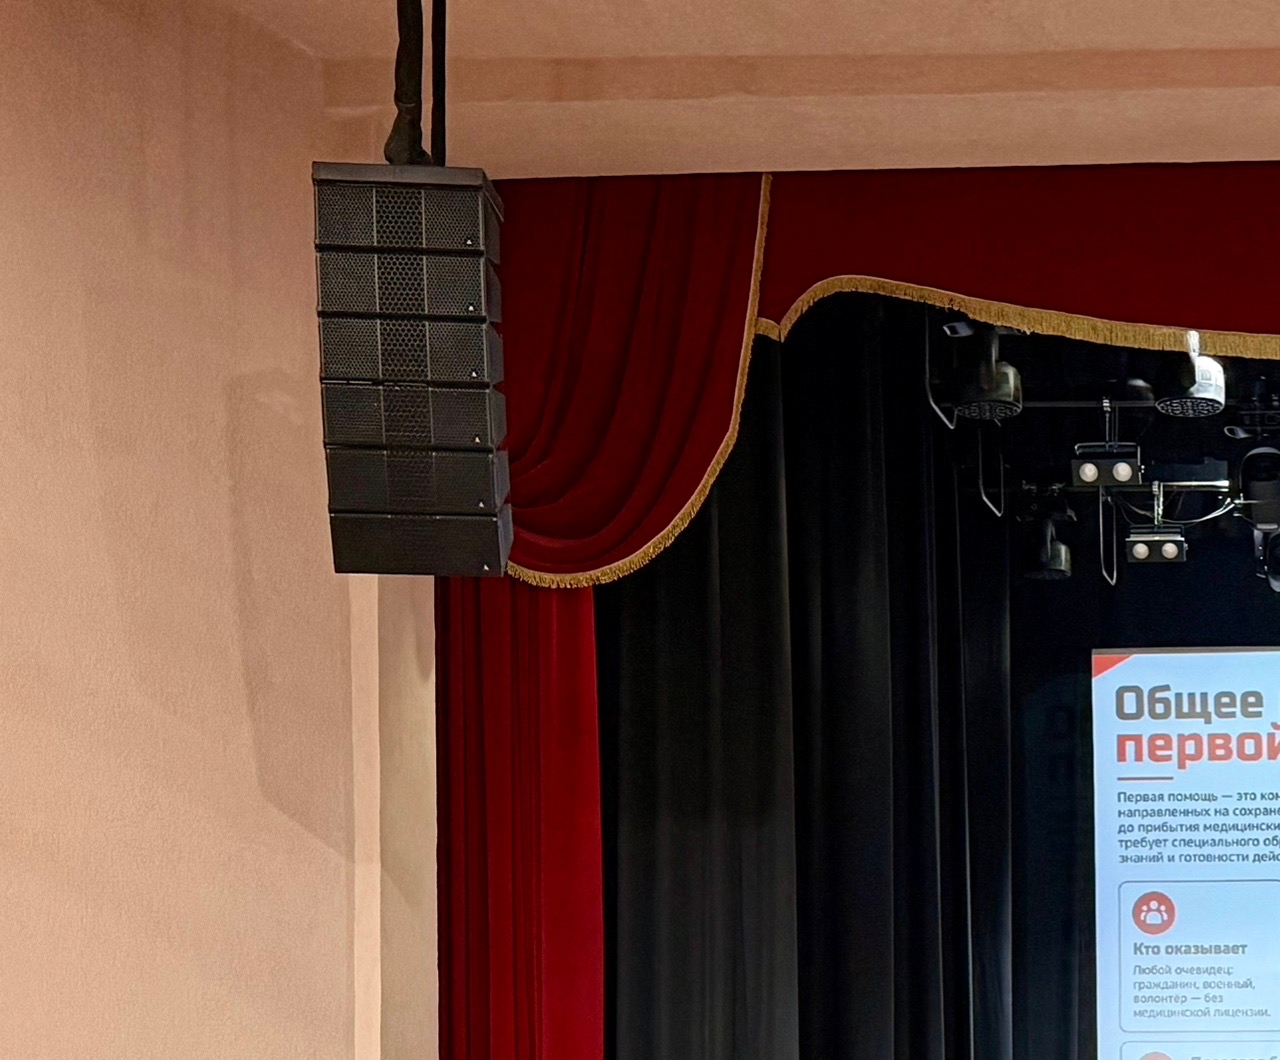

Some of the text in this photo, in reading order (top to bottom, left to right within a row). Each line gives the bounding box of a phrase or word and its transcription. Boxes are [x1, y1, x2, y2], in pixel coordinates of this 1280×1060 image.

[1115, 684, 1263, 724] Общее
[1118, 792, 1164, 804] Первая
[1168, 792, 1218, 803] помощь
[1237, 791, 1257, 802] это
[1118, 807, 1211, 820] направленных
[1214, 807, 1229, 817] на
[1118, 823, 1134, 835] до
[1138, 822, 1199, 834] прибытия
[1118, 837, 1168, 850] требует
[1172, 837, 1260, 850] специального
[1119, 851, 1164, 864] знаний
[1167, 854, 1176, 863] и
[1179, 853, 1249, 863] готовности
[1134, 942, 1248, 956] Кто оказывает
[1133, 964, 1171, 976] Любой
[1133, 977, 1255, 992] гражданин, военный,
[1204, 992, 1223, 1004] без
[1134, 1006, 1271, 1019] медицинской лицензии.
